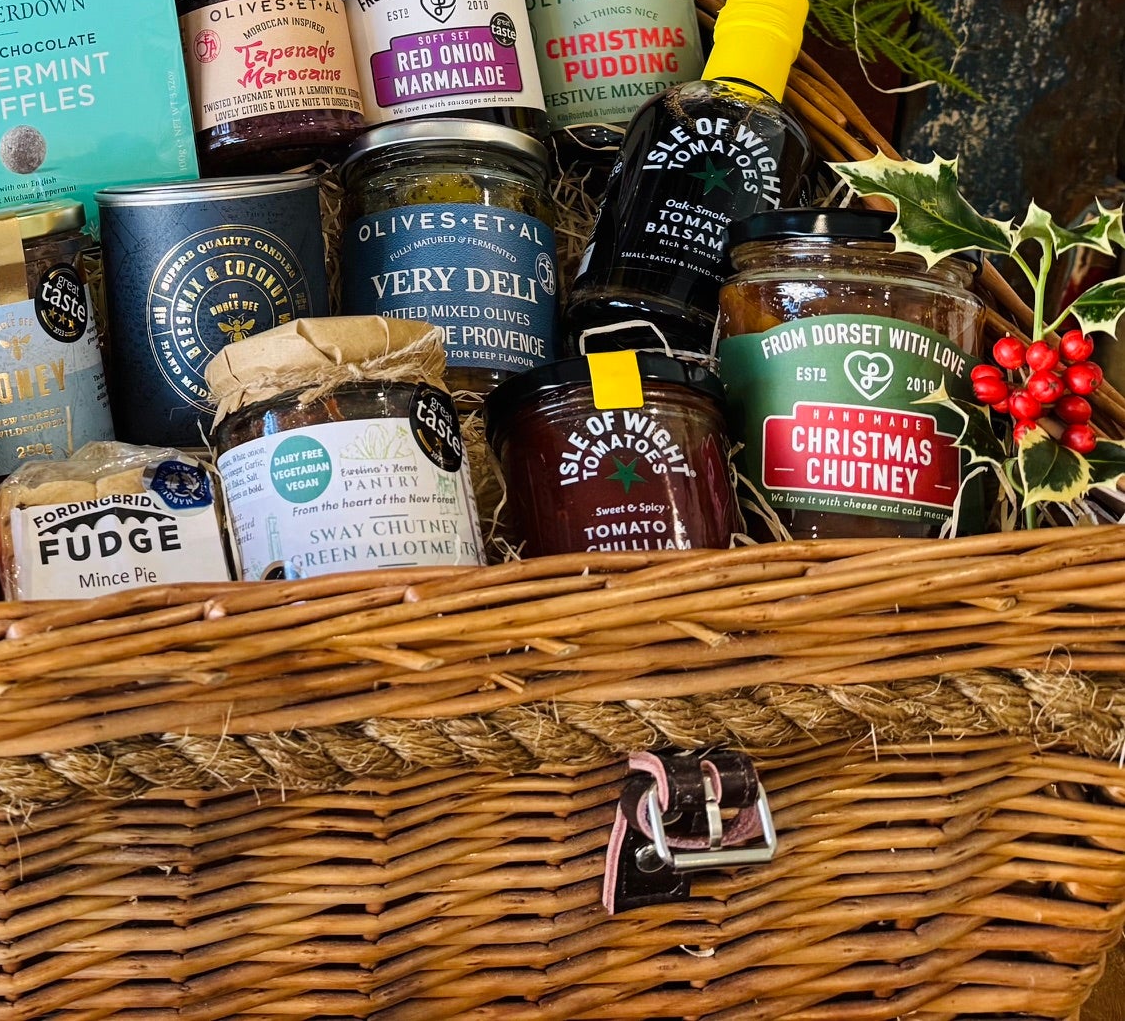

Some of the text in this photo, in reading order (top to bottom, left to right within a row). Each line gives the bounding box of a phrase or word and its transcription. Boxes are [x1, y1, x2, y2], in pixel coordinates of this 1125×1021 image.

[243, 17, 325, 40] MOROCCAN INSPIRED
[418, 31, 470, 45] SOFT SET
[491, 25, 516, 40] taste
[234, 40, 335, 68] Tapenade
[397, 42, 495, 72] RED ONION
[546, 27, 686, 59] CHRISTMAS
[237, 66, 341, 89] Marocaine
[563, 52, 679, 83] PUDDING
[394, 66, 506, 98] MARMALADE
[642, 118, 782, 210] ISLE OF WIGHT
[667, 139, 759, 195] TOMATOES
[197, 236, 251, 253] QUALITY
[371, 267, 539, 304] VERY DELI
[41, 281, 86, 323] taste
[431, 306, 531, 326] MIXED OLIVES
[463, 326, 546, 359] PROVENCE
[761, 323, 966, 379] FROM DORSET WITH LOVE
[906, 377, 934, 394] 2010
[813, 409, 921, 431] HANDMADE
[274, 448, 323, 467] DAIRY FREE
[559, 411, 691, 486] ISLE OF WIGHT
[583, 434, 668, 481] TOMATOES
[792, 426, 932, 466] CHRISTMAS
[272, 462, 330, 480] VEGETARIAN
[286, 478, 319, 492] VEGAN
[806, 458, 919, 495] CHUTNEY
[595, 503, 665, 516] Sweet Spicy
[310, 519, 459, 544] SWAY CHUTNEY
[584, 521, 666, 540] TOMATO
[38, 525, 181, 565] FUDGE
[79, 567, 157, 589] Mince Pie
